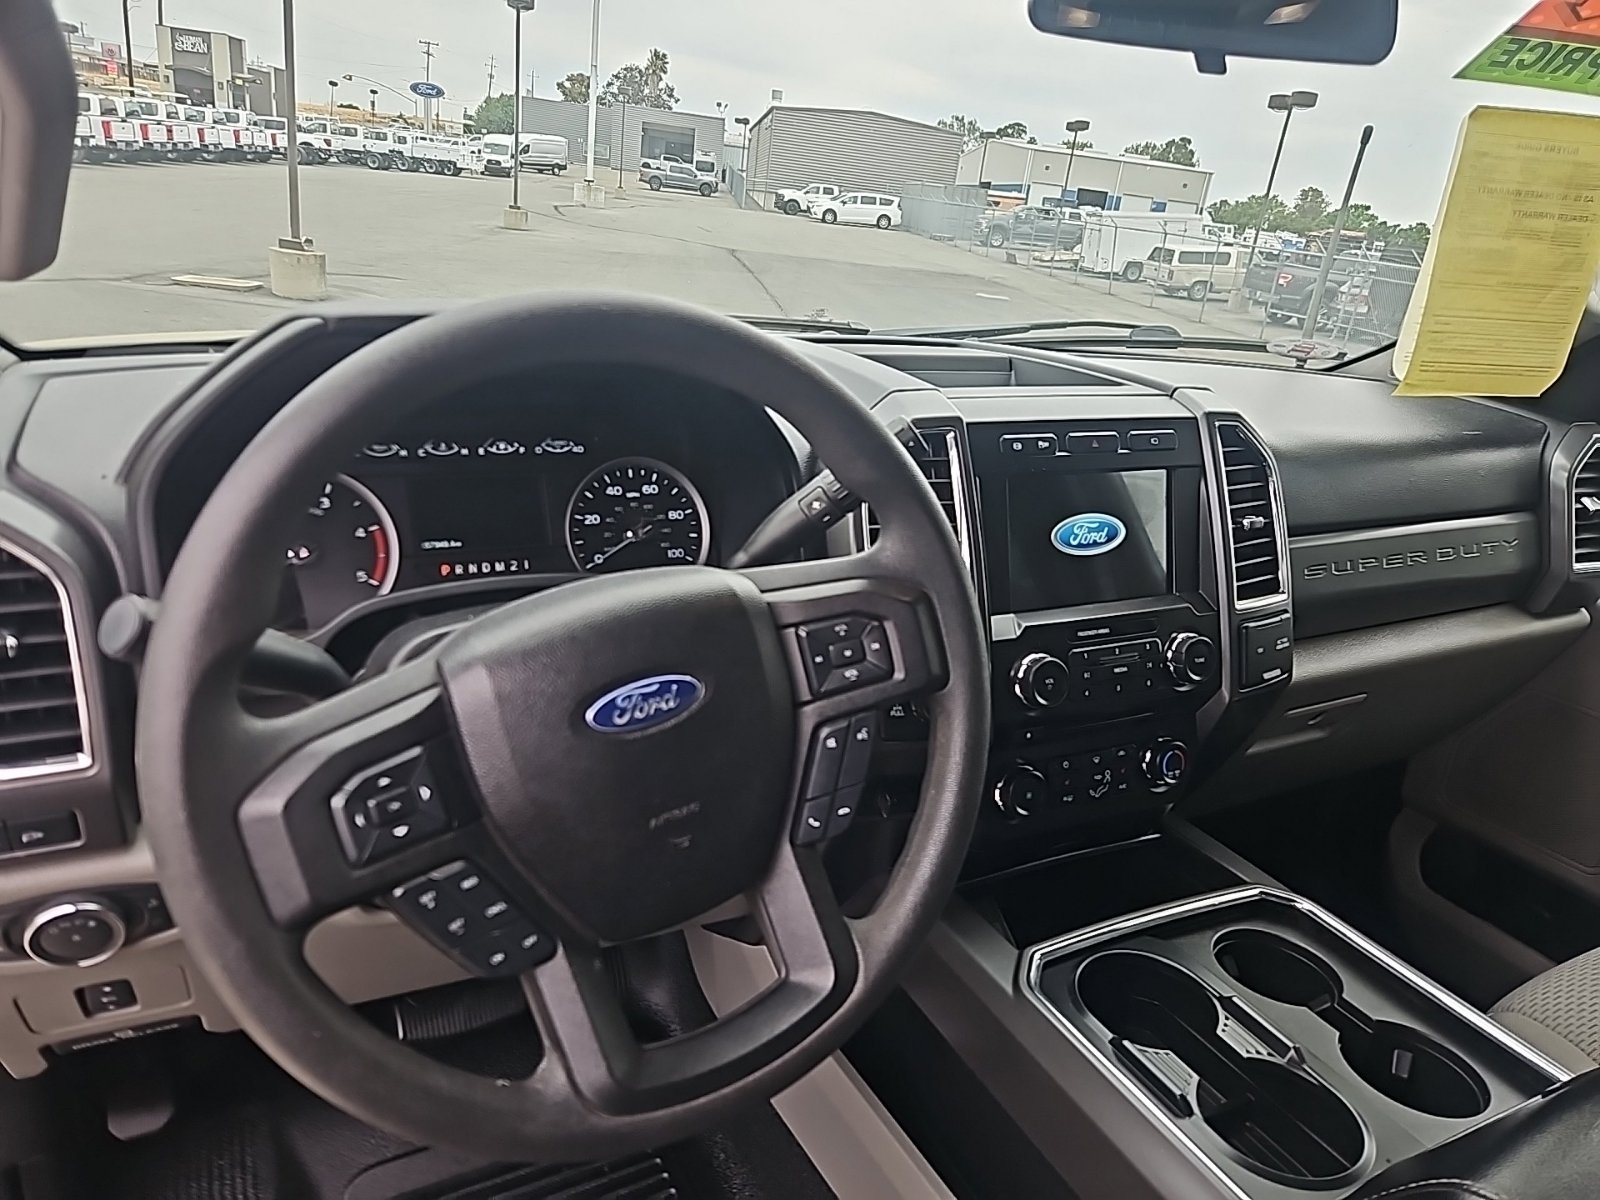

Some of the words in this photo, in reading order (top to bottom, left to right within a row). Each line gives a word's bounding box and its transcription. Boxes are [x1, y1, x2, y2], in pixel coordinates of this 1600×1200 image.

[184, 40, 208, 54] BEAN
[416, 83, 438, 96] Ford
[605, 485, 622, 496] 40
[641, 484, 659, 495] 60
[319, 496, 331, 509] 3
[583, 513, 601, 525] 20
[667, 509, 684, 520] 80
[355, 527, 367, 538] 4
[1069, 522, 1109, 546] Ford
[667, 548, 685, 559] 100
[1303, 550, 1428, 580] SUPER
[1436, 538, 1519, 563] DUTY
[440, 564, 451, 577] P
[454, 563, 464, 575] R
[468, 562, 478, 574] N
[481, 561, 491, 574] D
[494, 561, 506, 572] M
[509, 560, 519, 572] 2
[356, 570, 368, 582] 5
[612, 682, 681, 727] Ford
